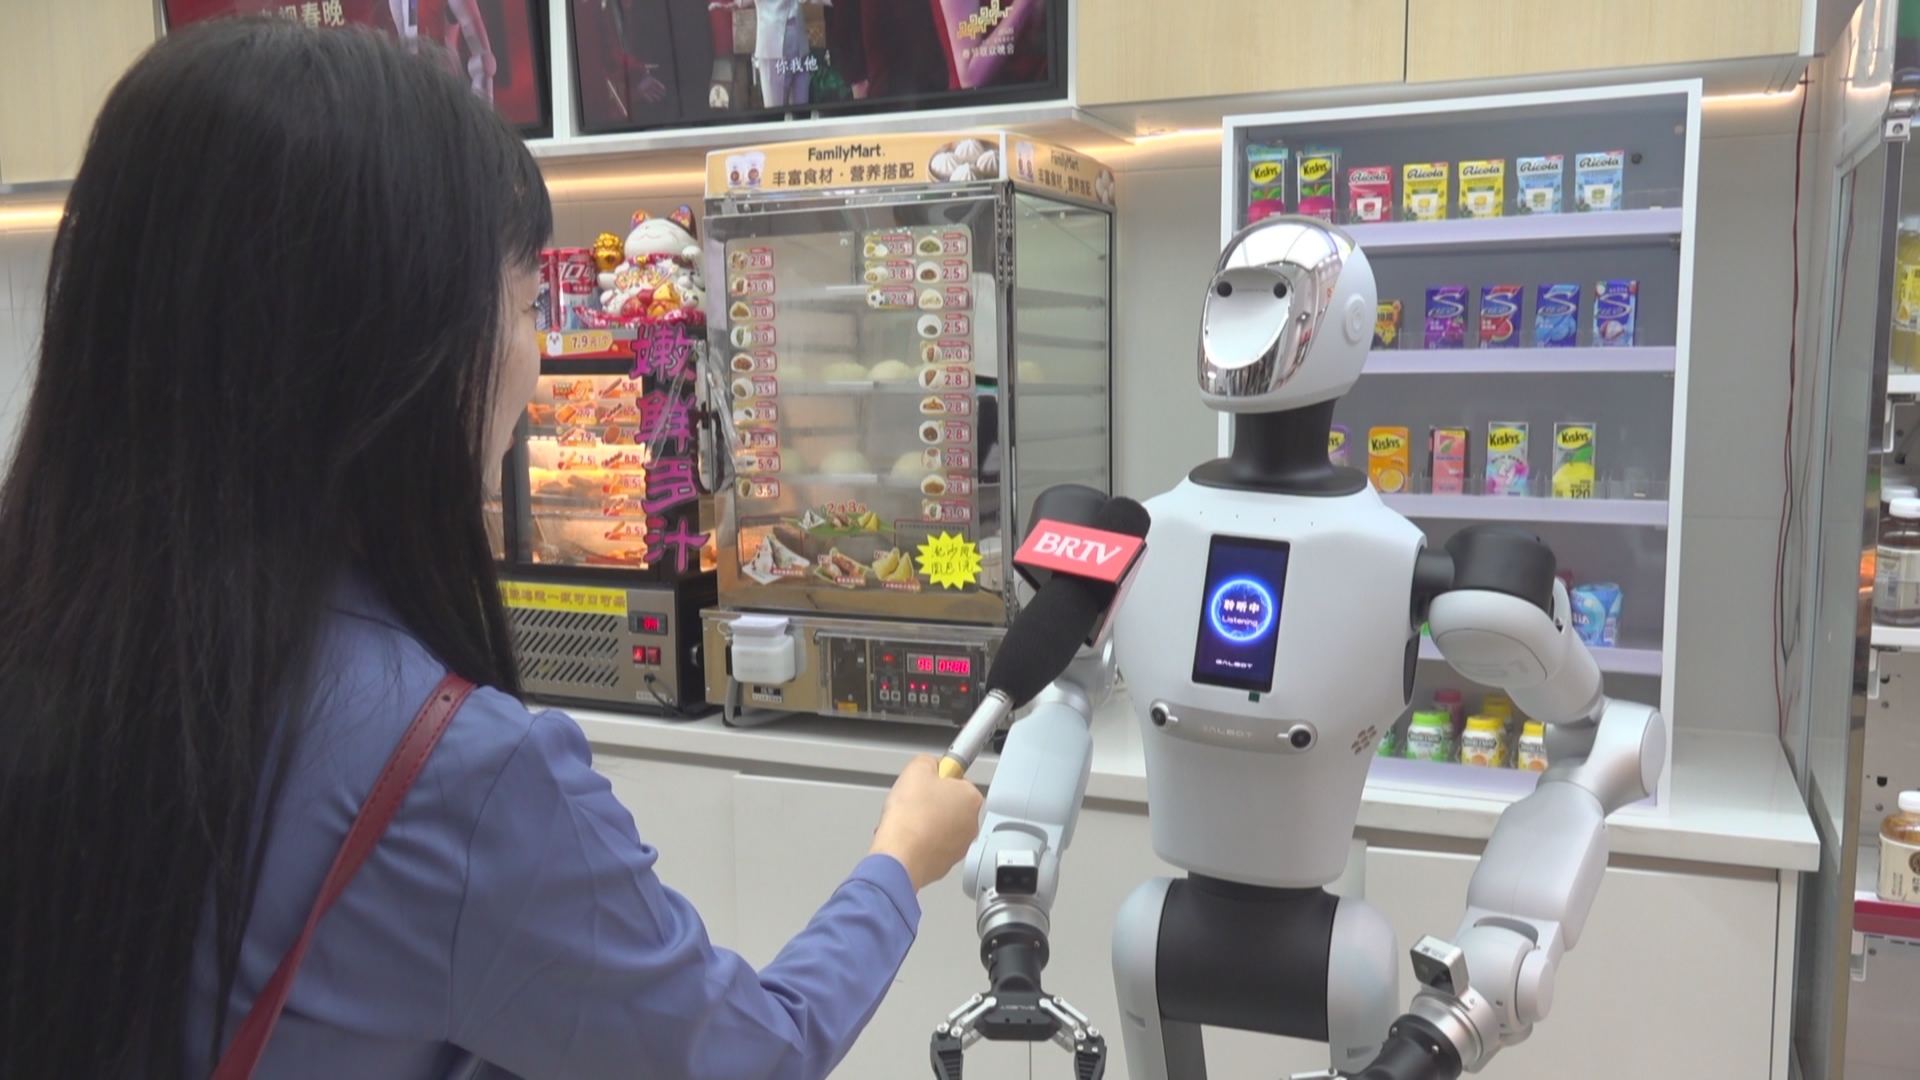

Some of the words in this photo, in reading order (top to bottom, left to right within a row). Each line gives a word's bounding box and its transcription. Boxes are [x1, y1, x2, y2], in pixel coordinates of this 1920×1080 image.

[775, 55, 819, 74] 你我他
[807, 144, 882, 162] FamilyMart
[1519, 161, 1559, 174] Ricola
[1579, 156, 1619, 169] Ricola
[1406, 168, 1444, 179] Ricola
[1462, 164, 1500, 177] Ricola
[1351, 171, 1388, 184] Ricola
[1570, 488, 1591, 499] 120
[1032, 531, 1122, 566] BRTV
[1221, 614, 1259, 628] Listening
